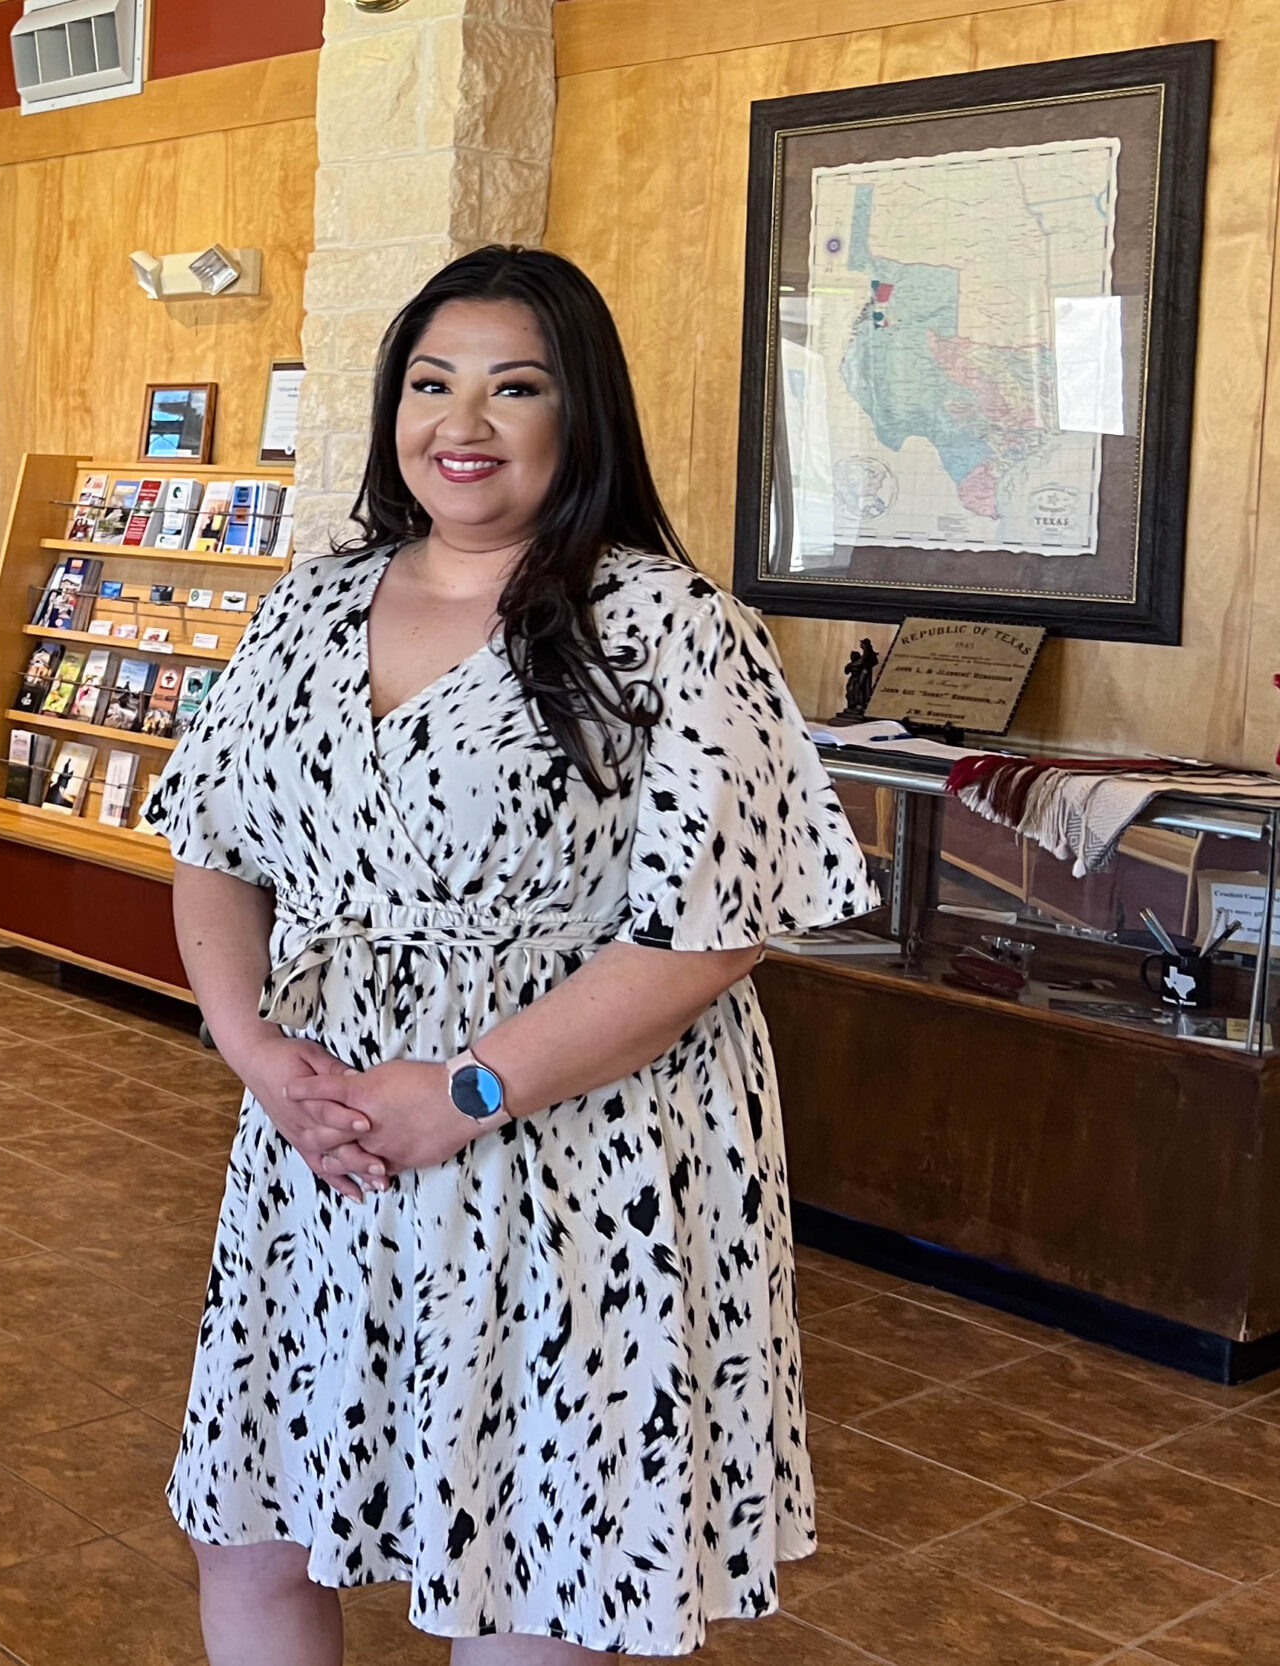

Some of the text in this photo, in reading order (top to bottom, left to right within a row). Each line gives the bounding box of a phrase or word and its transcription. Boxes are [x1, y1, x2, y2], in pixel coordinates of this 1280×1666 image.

[1034, 516, 1069, 527] TEXAS
[901, 624, 1032, 656] REPUBLIC OF TEXAS
